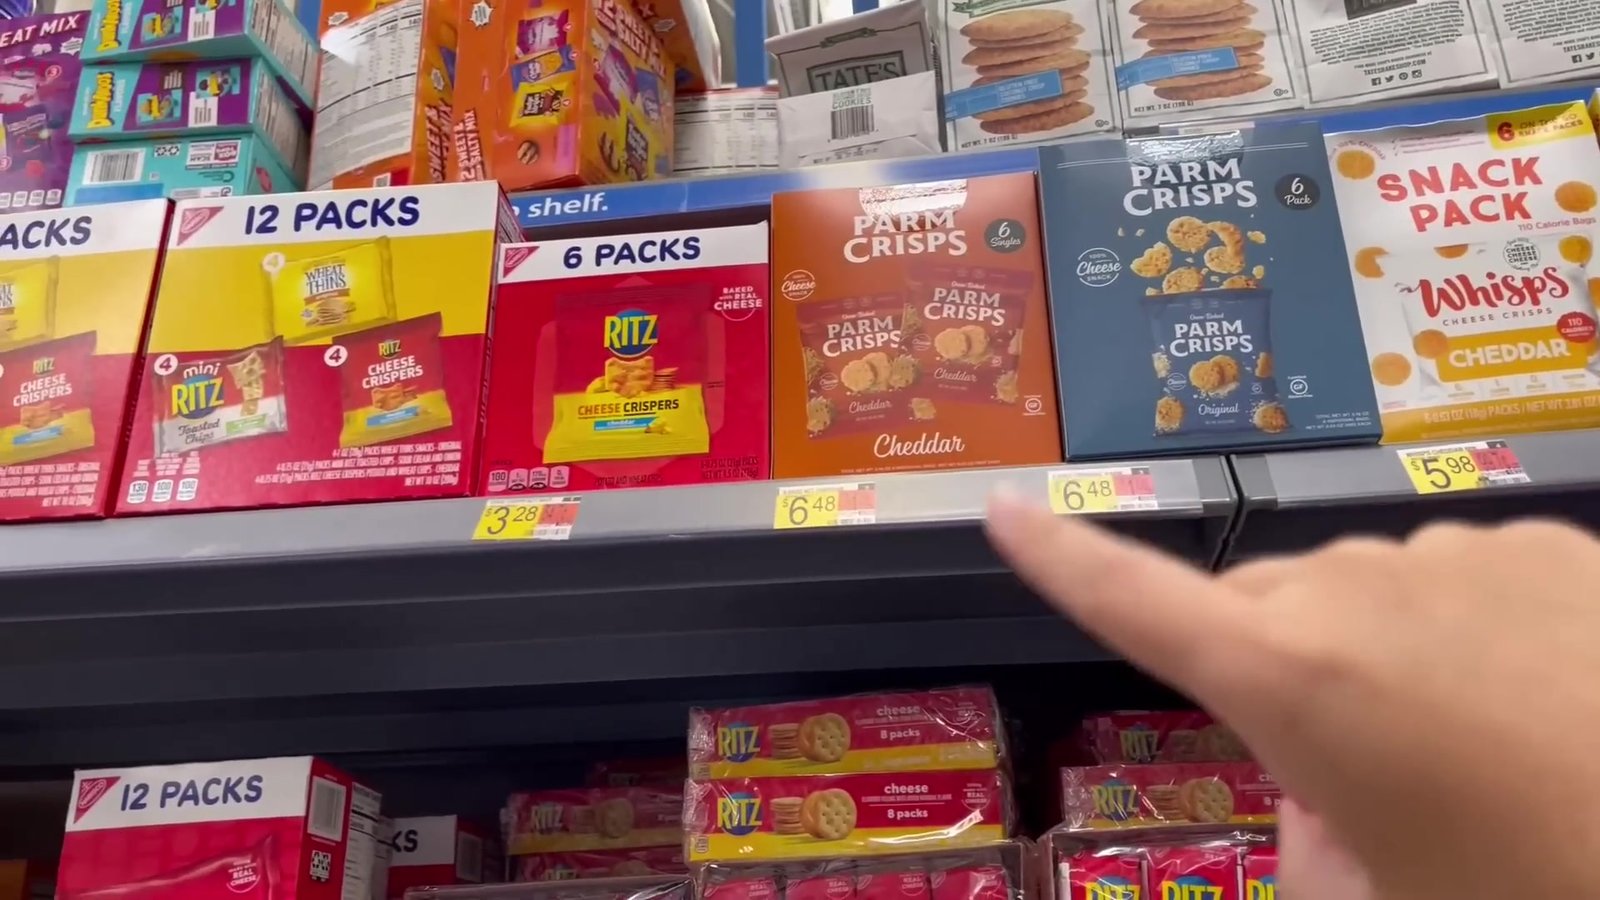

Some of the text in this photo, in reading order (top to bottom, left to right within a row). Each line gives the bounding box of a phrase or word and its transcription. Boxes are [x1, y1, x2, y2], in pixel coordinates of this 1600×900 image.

[39, 14, 82, 36] MIX
[815, 62, 899, 91] TATE'S
[832, 97, 871, 109] COOKIES
[464, 110, 476, 132] MIX
[1497, 121, 1515, 142] 6
[455, 132, 468, 169] SWEET
[466, 133, 481, 166] SALTY
[1130, 158, 1241, 187] PARM
[1377, 156, 1543, 202] SNACK
[1291, 178, 1304, 194] 6
[527, 192, 609, 217] shelf.
[1123, 181, 1257, 216] CRISPS
[1284, 195, 1312, 207] Pack
[245, 196, 420, 235] 12 PACKS
[1409, 192, 1533, 233] PACK
[1535, 217, 1571, 230] Calorie
[1572, 215, 1597, 226] Bags
[0, 216, 92, 250] ACKS
[853, 210, 957, 237] PARM
[998, 221, 1010, 238] 6
[563, 236, 701, 269] 6 PACKS
[843, 230, 967, 263] CRISPS
[990, 237, 1021, 248] Singles
[1506, 245, 1535, 253] CHEESE
[1077, 261, 1121, 276] Cheese
[1508, 255, 1537, 263] CHEESE
[305, 263, 346, 281] WHEAT
[307, 276, 346, 295] THINS
[723, 286, 754, 295] BAKED
[781, 280, 816, 292] Cheese
[1412, 267, 1569, 318] Whisps
[714, 299, 763, 311] CHEESE
[734, 292, 757, 301] REAL
[934, 287, 999, 307] PARM
[924, 302, 1006, 326] CRISPS
[1442, 307, 1553, 327] CHEESE CRISPS
[1568, 318, 1583, 326] 110
[604, 314, 659, 349] RITZ
[827, 315, 894, 338] PARM
[1175, 320, 1243, 338] PARM
[378, 340, 401, 357] RITZ
[822, 330, 902, 357] CRISPS
[1170, 334, 1253, 357] CRISPS
[1449, 338, 1572, 368] CHEDDAR
[159, 357, 171, 371] 4
[329, 348, 341, 362] 4
[33, 358, 55, 374] RITZ
[184, 361, 221, 379] mini
[368, 355, 415, 377] CHEESE
[934, 368, 977, 383] Cheddar
[20, 374, 66, 394] CHEESE
[362, 365, 423, 389] CRISPERS
[13, 383, 72, 407] CRISPERS
[172, 377, 224, 416] RITZ
[578, 399, 680, 416] CHEESE CRISPERS
[849, 400, 892, 413] Cheddar
[1198, 403, 1240, 417] Original
[178, 419, 220, 436] Toasted
[185, 431, 214, 445] Chips
[874, 432, 965, 458] Cheddar
[132, 483, 147, 492] 130
[876, 704, 920, 716] cheese
[717, 726, 760, 756] RITZ
[880, 728, 920, 741] 8 packs
[1120, 730, 1158, 762] RITZ
[121, 775, 264, 811] 12 PACKS
[884, 783, 928, 794] cheese
[1091, 784, 1138, 816] RITZ
[717, 798, 762, 829] RITZ
[887, 808, 928, 820] 8 packs
[230, 875, 257, 886] CHEESE
[232, 867, 254, 879] REAL
